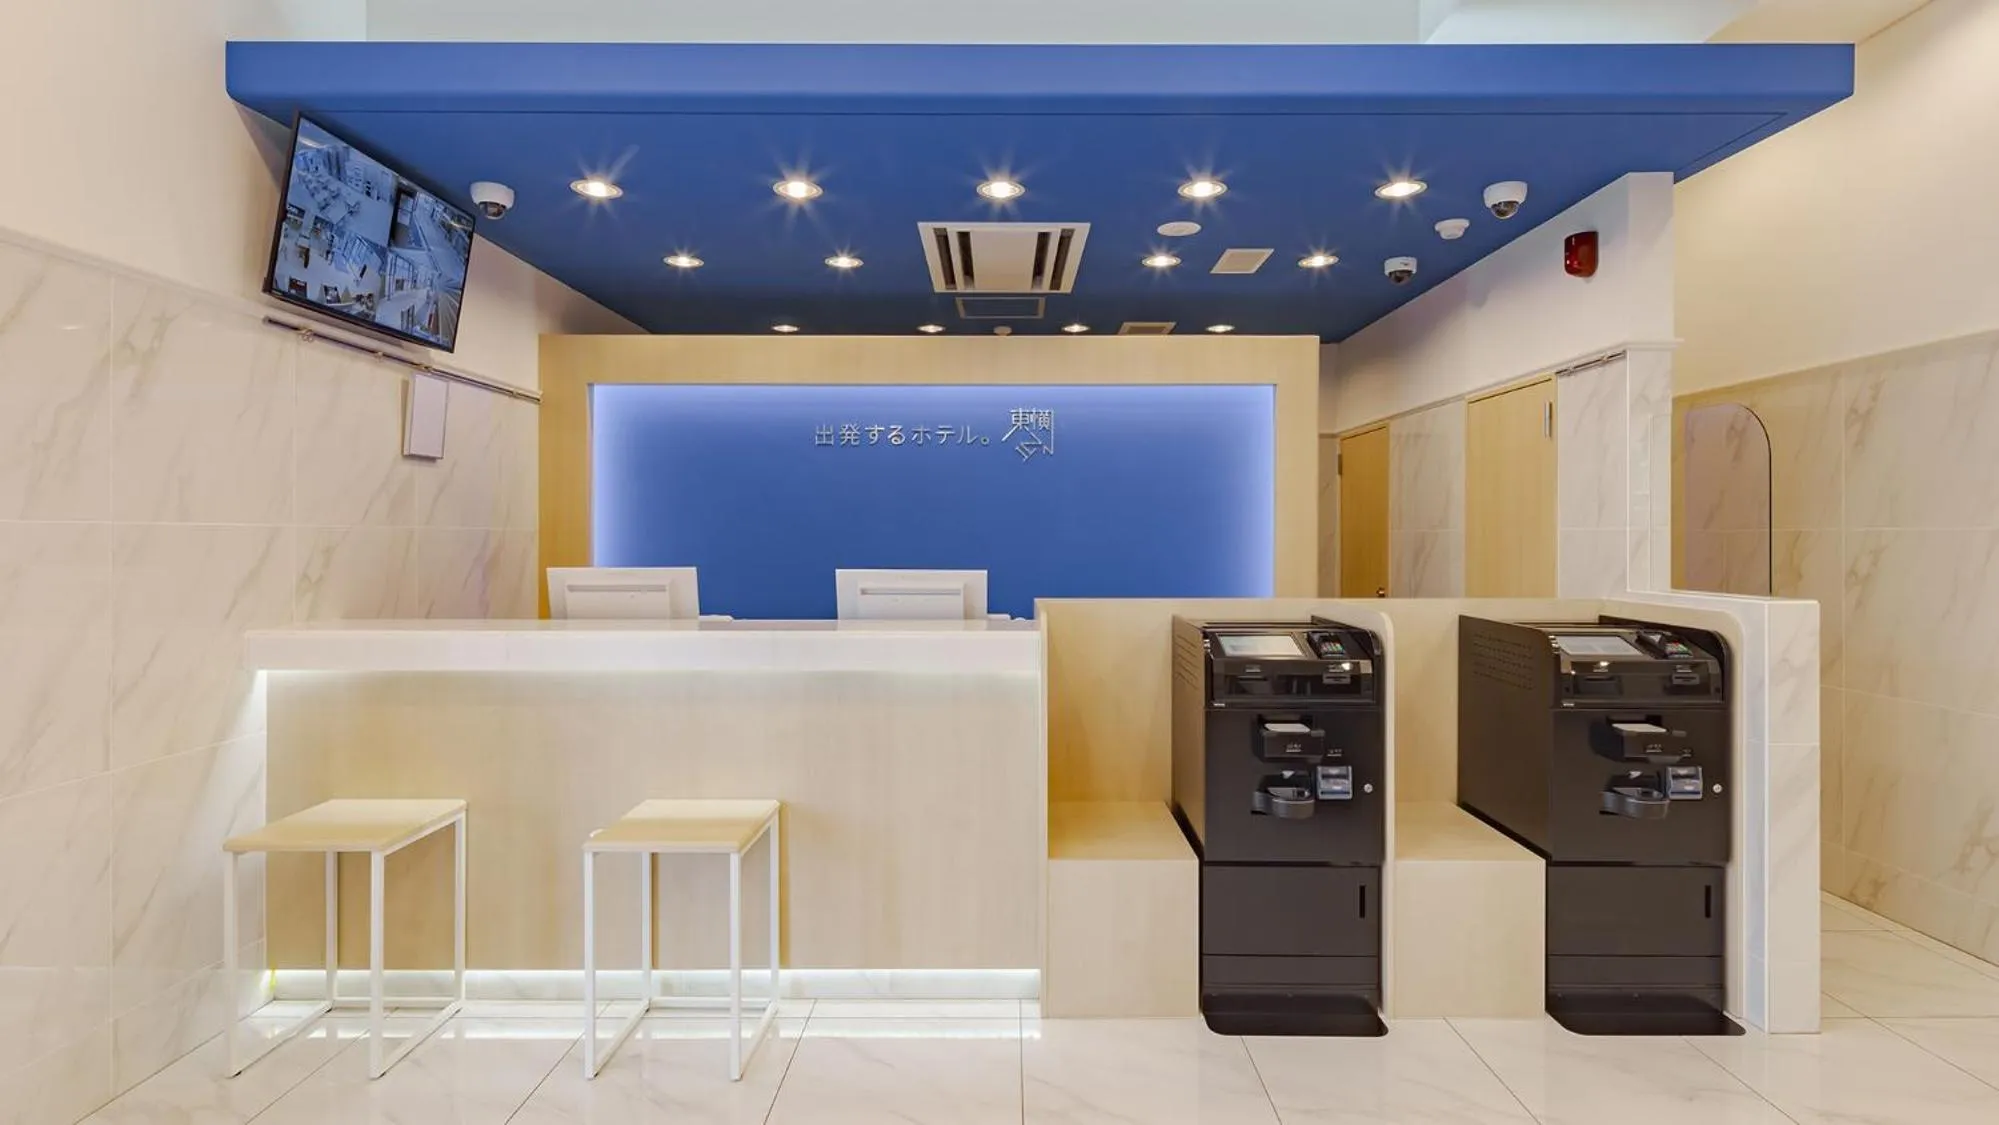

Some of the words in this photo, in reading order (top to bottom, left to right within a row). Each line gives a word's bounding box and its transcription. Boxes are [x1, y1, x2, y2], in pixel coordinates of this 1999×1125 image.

[815, 423, 990, 446] 出発するホテル。
